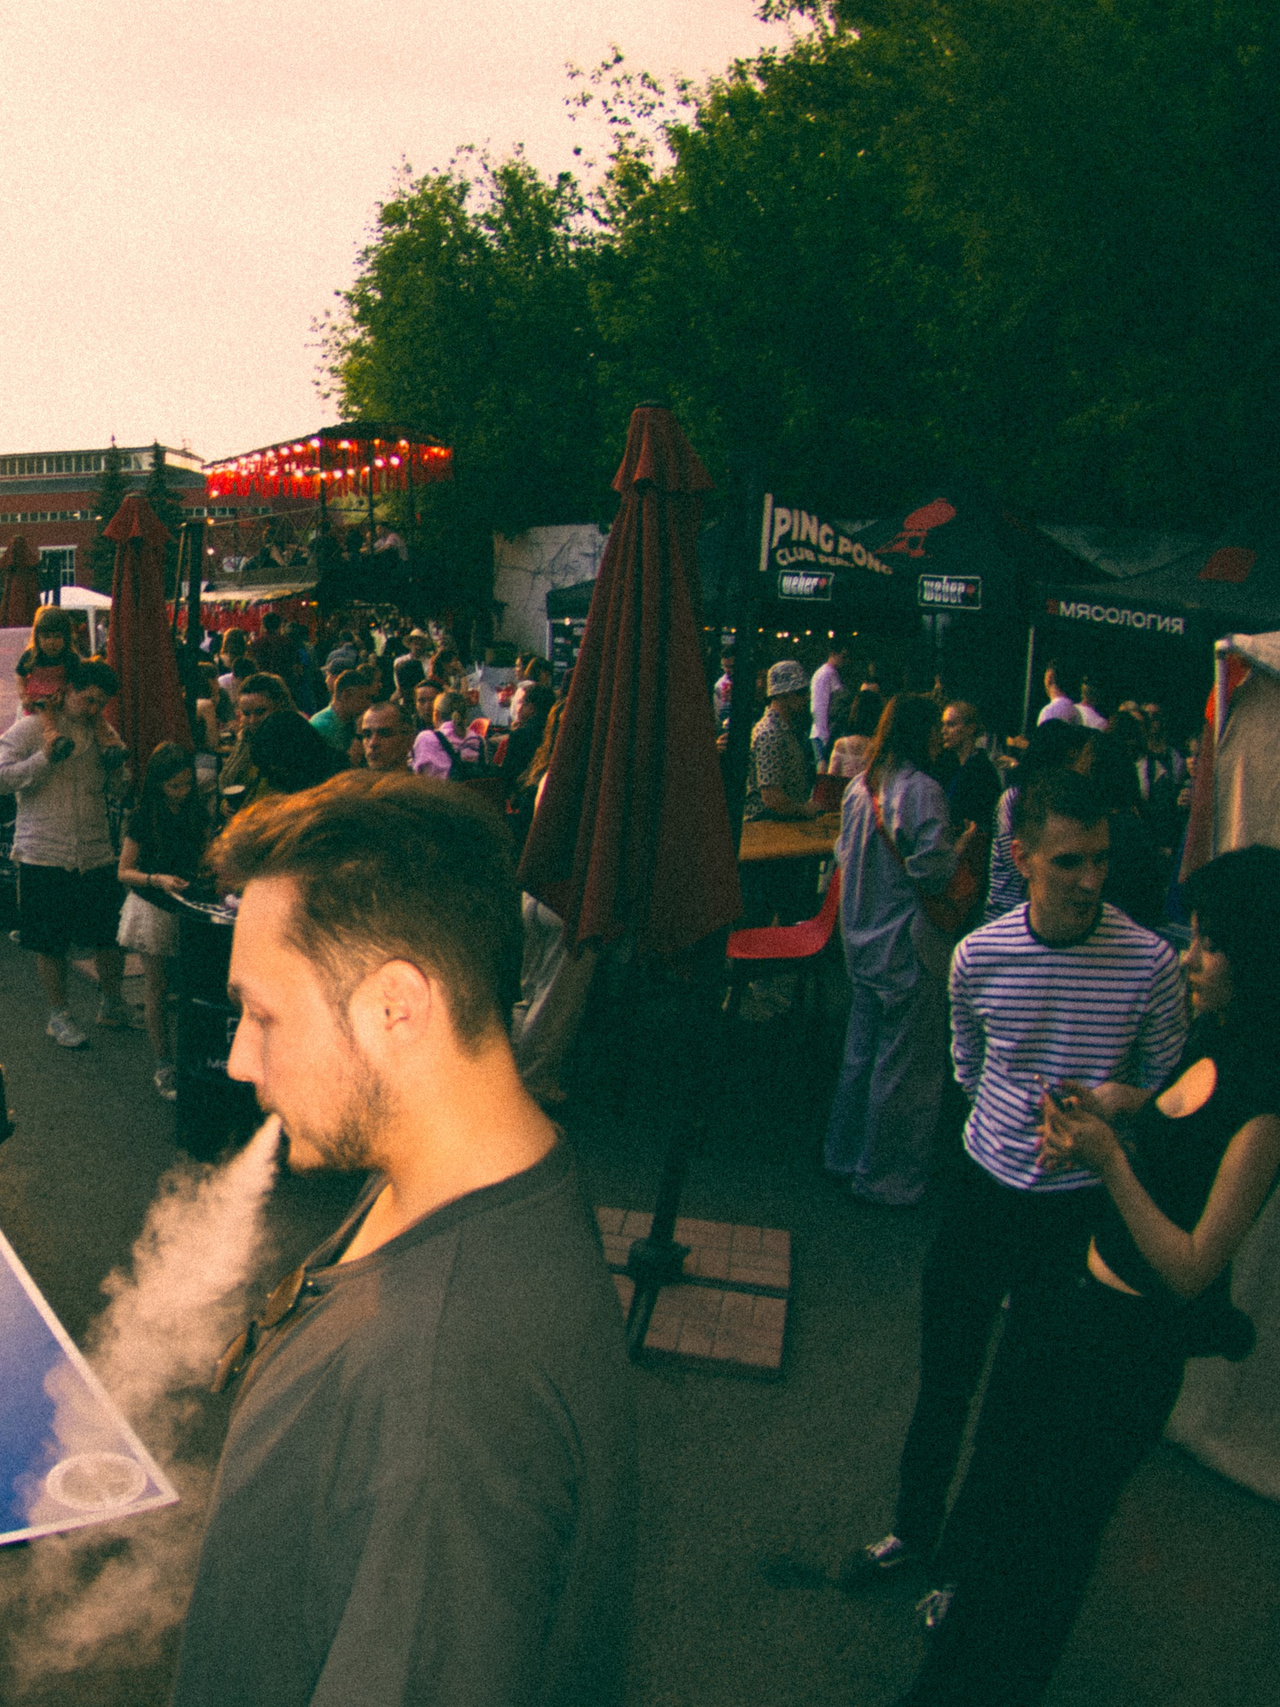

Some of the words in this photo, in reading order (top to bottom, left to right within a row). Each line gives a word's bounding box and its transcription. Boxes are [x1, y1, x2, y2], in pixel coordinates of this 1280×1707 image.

[772, 507, 834, 553] PING
[838, 535, 893, 575] PONG
[1060, 601, 1185, 635] МЯСОЛОГИЯ
